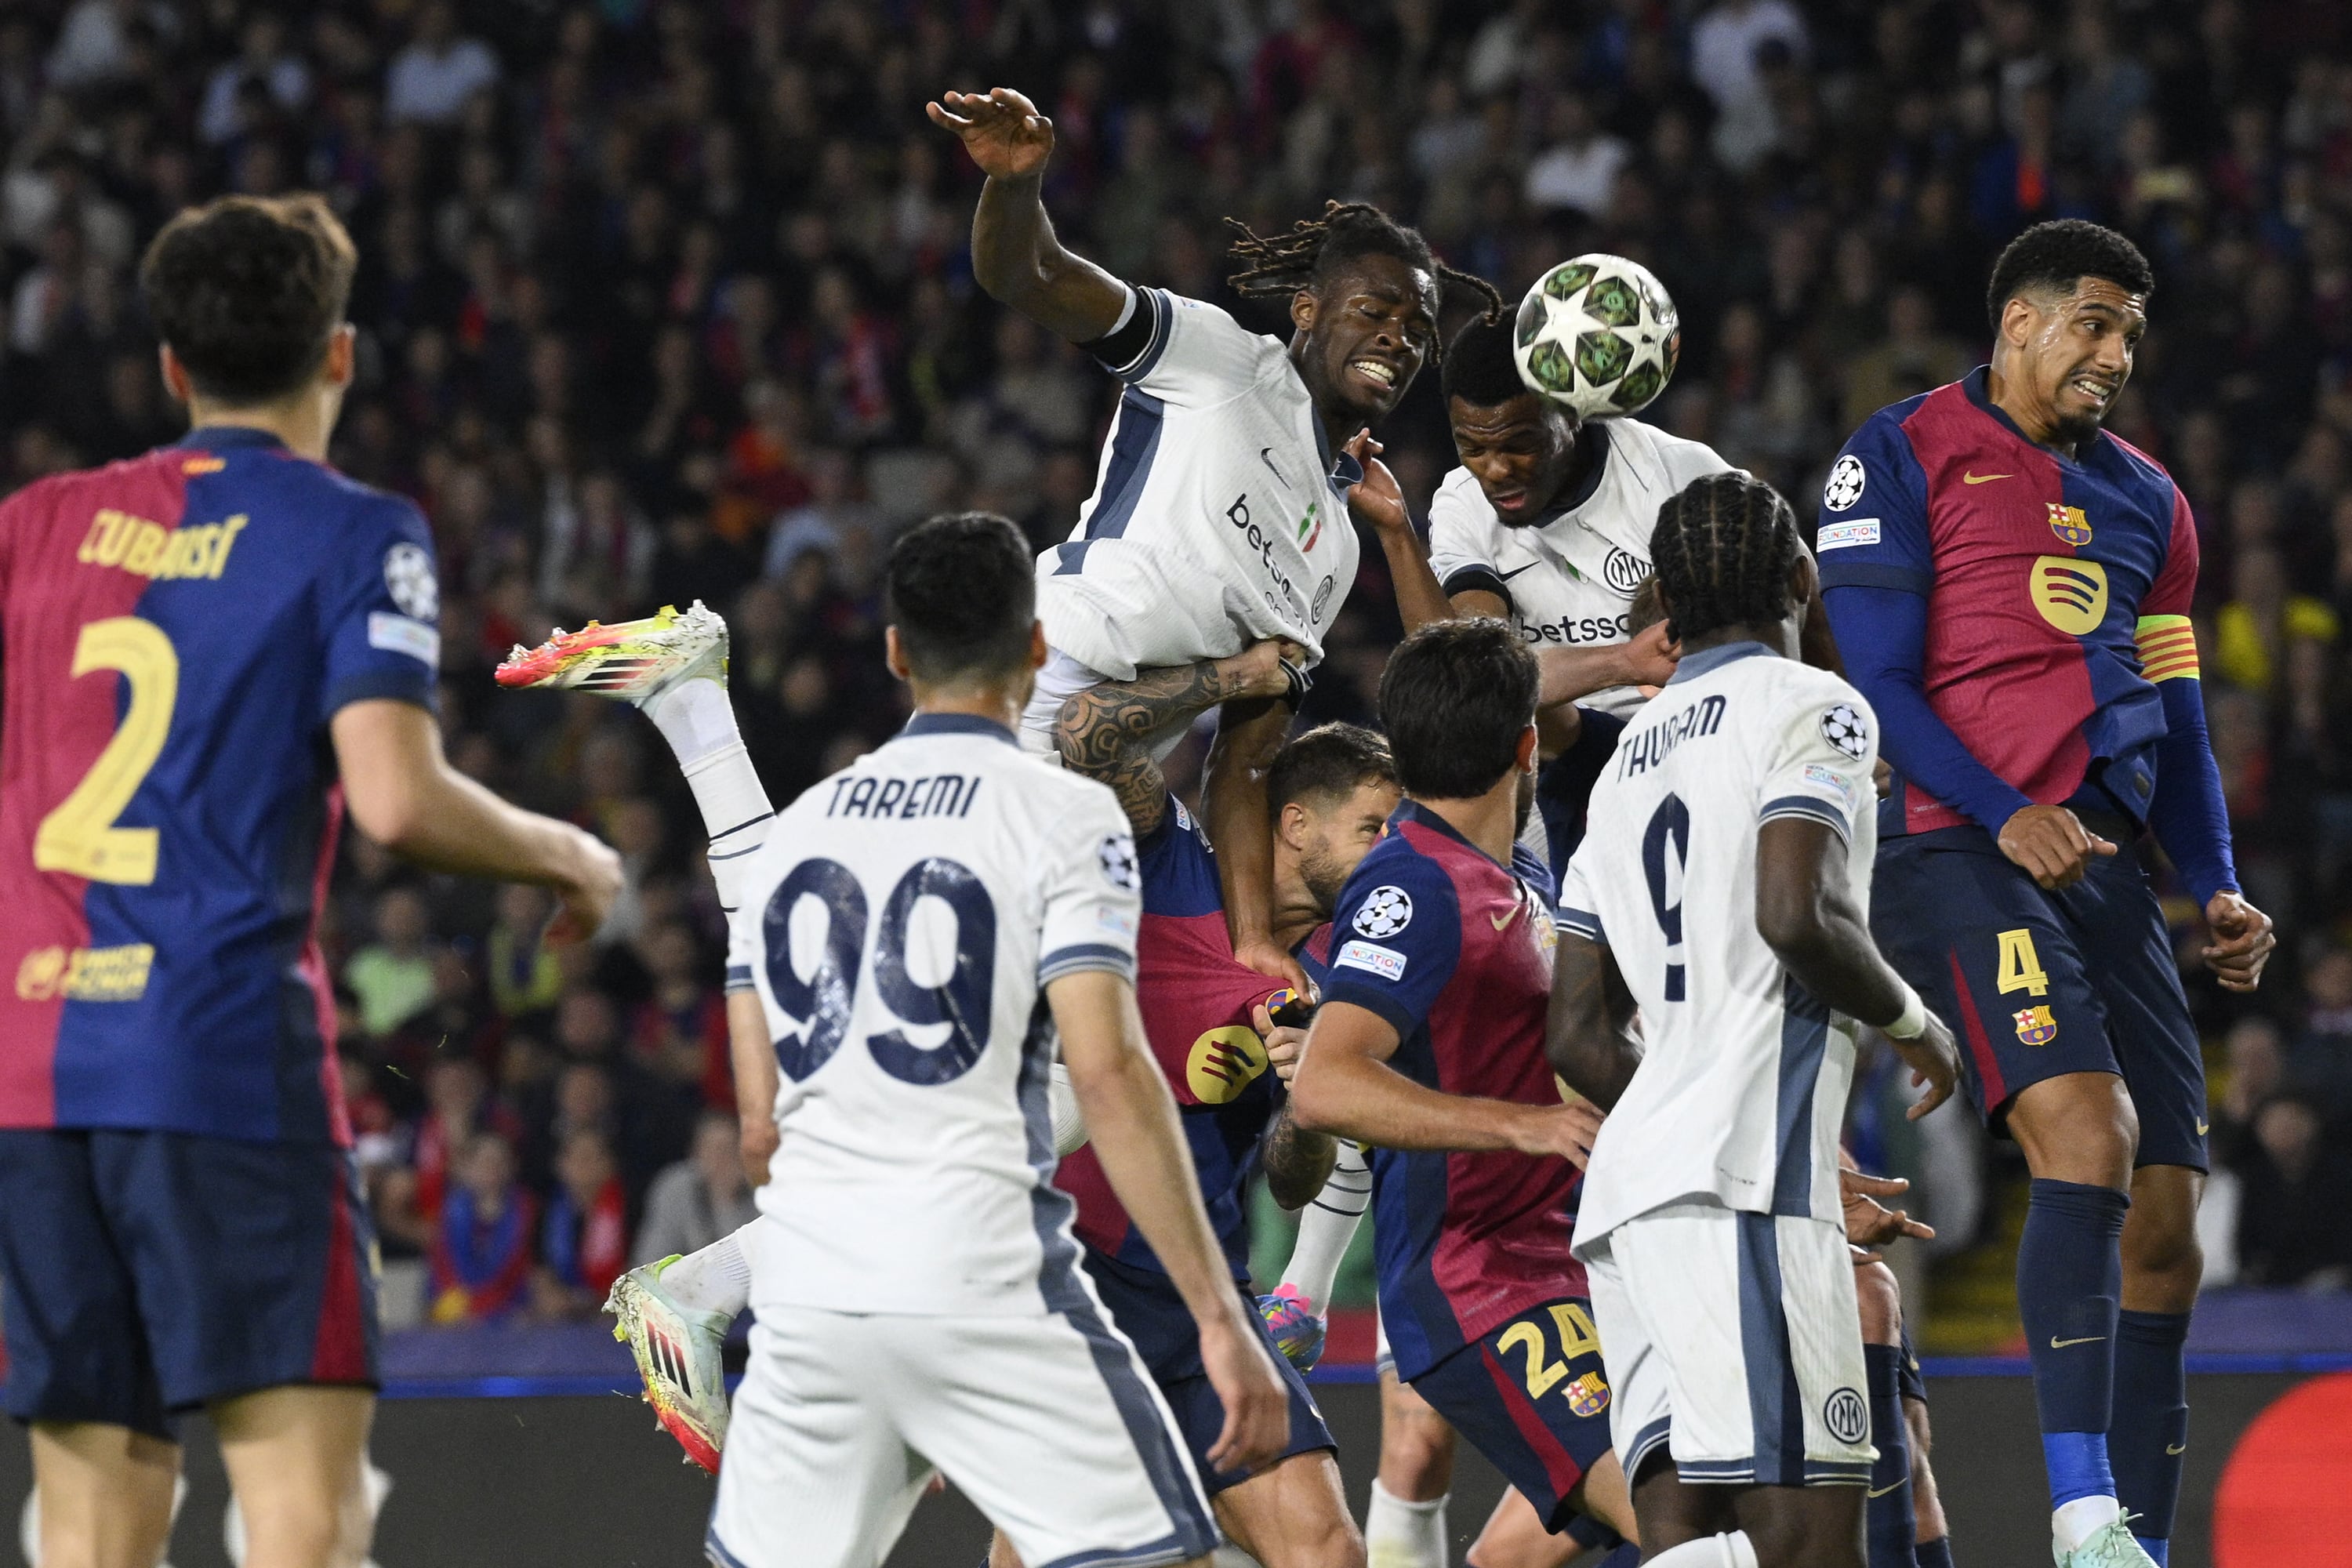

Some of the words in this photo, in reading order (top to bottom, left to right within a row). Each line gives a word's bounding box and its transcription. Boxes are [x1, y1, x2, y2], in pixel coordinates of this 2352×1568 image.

[34, 617, 179, 885] 2
[1617, 695, 1726, 783] THURAM
[828, 775, 981, 818] TAREMI
[762, 857, 997, 1086] 99
[1997, 928, 2049, 996] 4
[1497, 1303, 1603, 1399] 24
